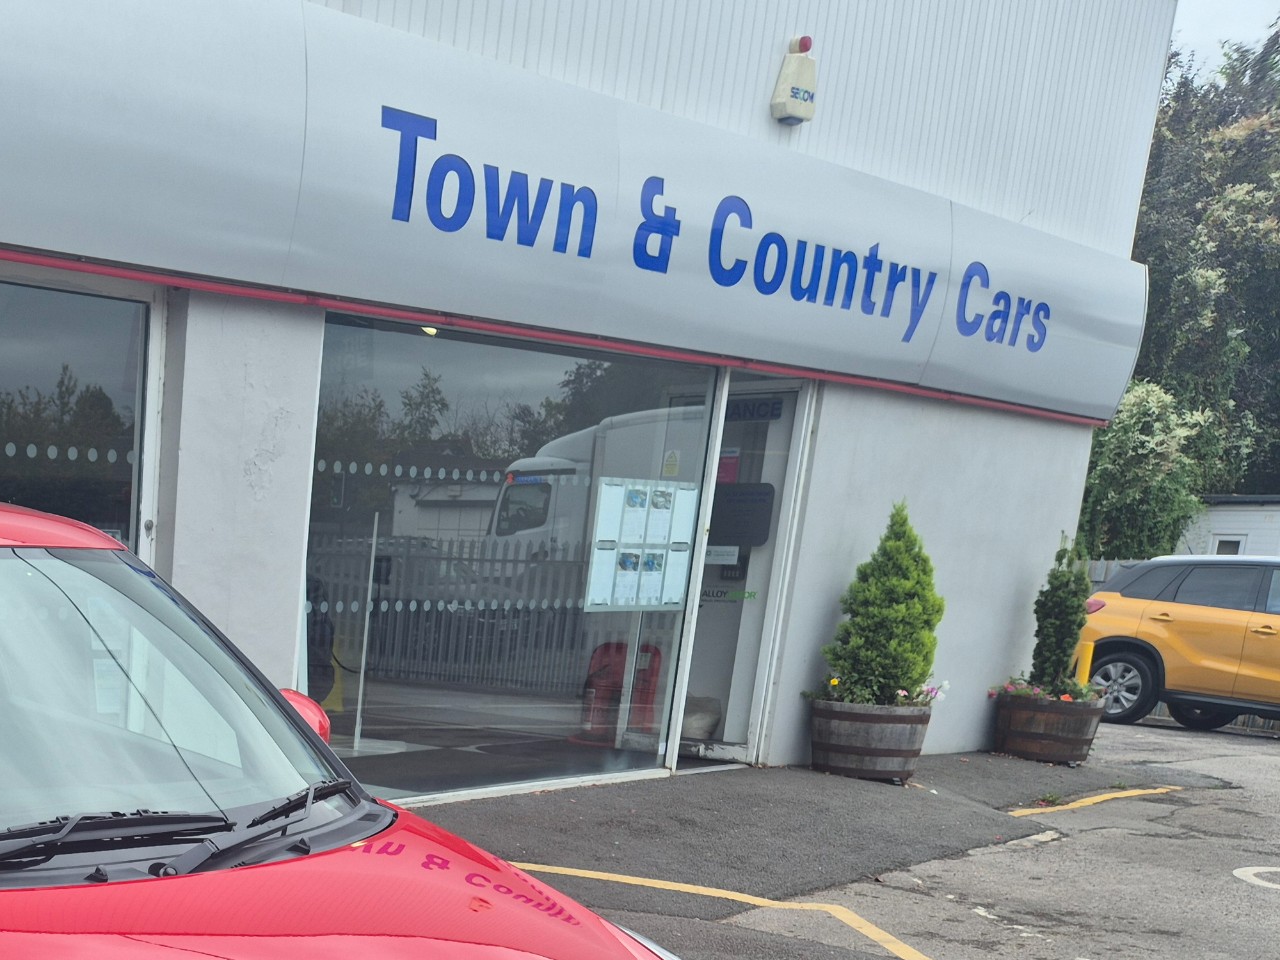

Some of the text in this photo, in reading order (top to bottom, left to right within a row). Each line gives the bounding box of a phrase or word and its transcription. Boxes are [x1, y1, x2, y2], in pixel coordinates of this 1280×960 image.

[381, 105, 1051, 352] Town & Country Cars
[727, 401, 783, 418] ANCE
